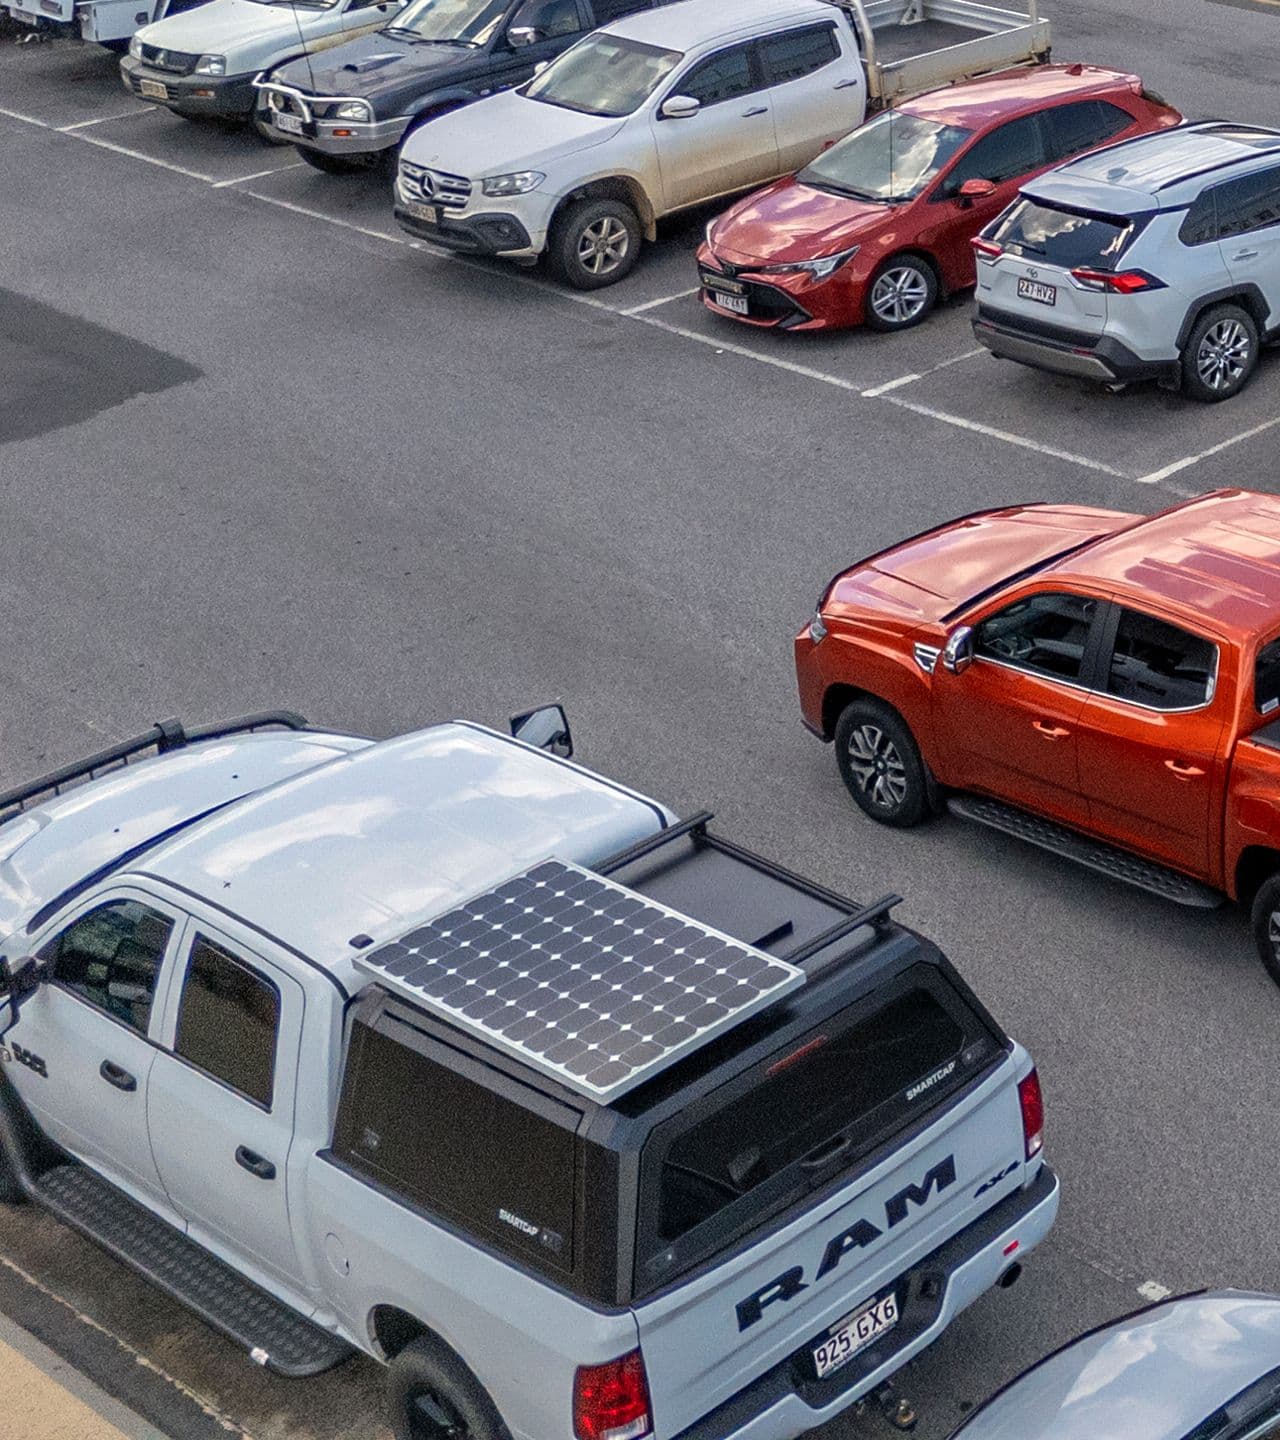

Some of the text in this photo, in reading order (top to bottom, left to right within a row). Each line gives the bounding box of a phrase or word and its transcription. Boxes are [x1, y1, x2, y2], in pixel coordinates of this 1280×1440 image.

[905, 1060, 956, 1102] SMARTCAP
[498, 1207, 539, 1237] SMARTCAP
[735, 1153, 958, 1333] RAM
